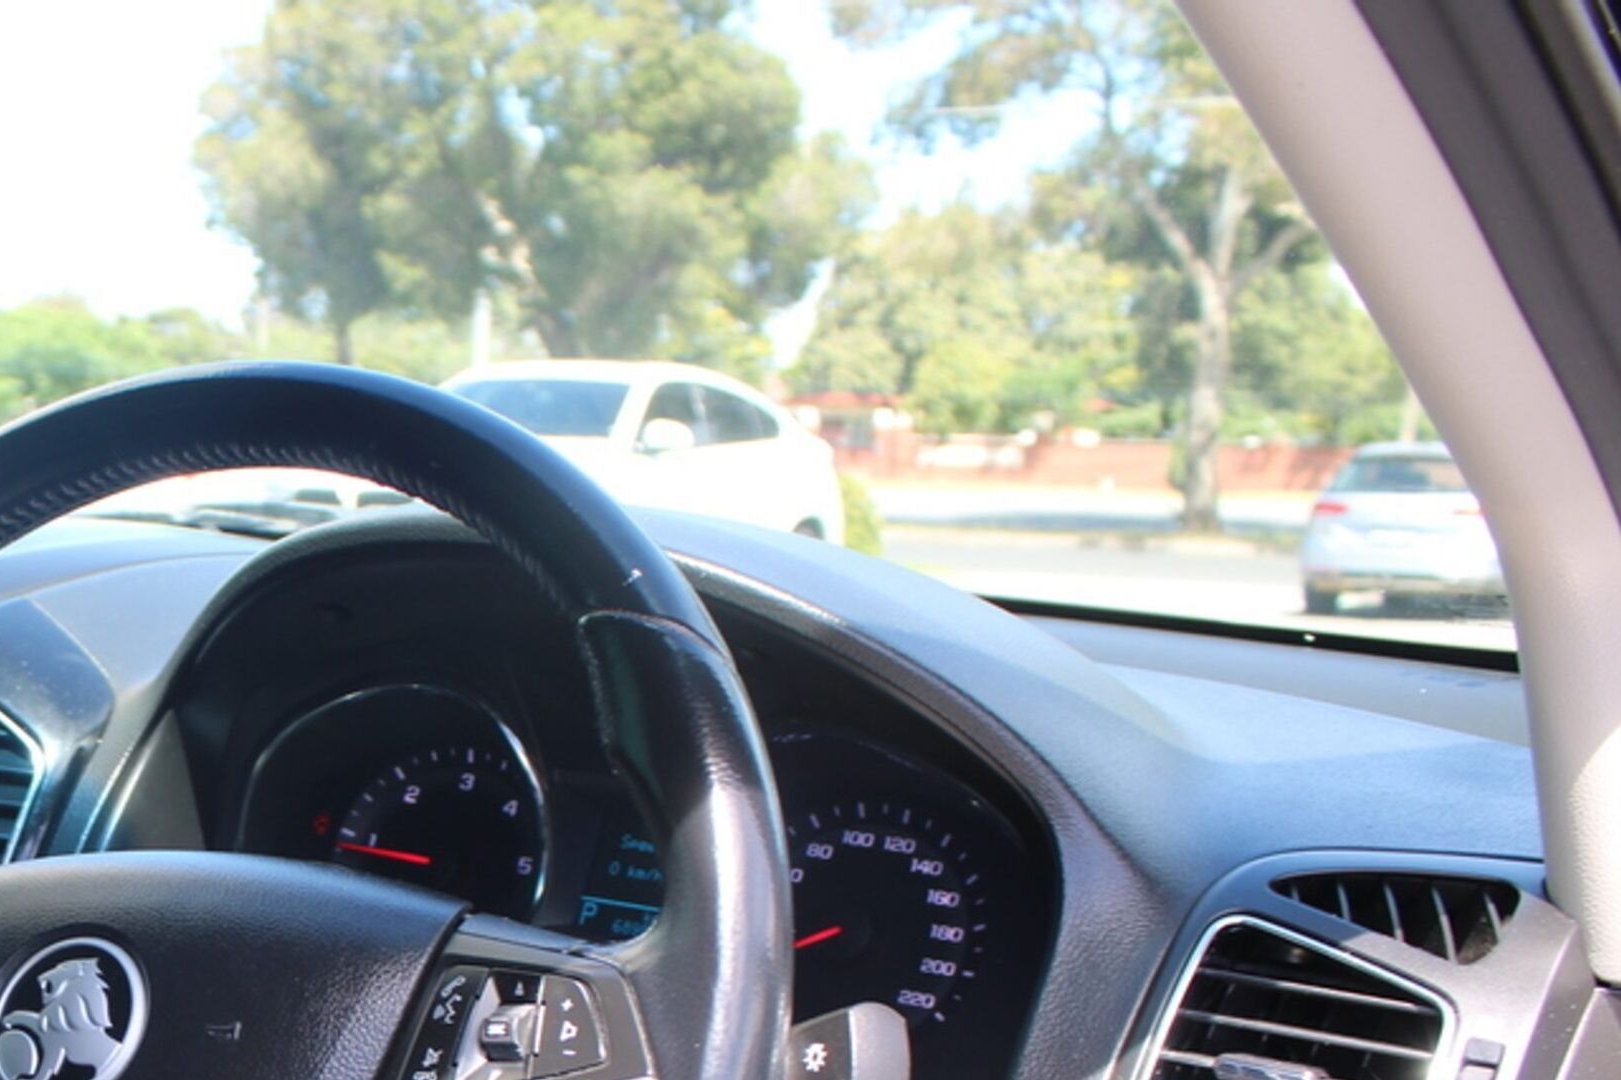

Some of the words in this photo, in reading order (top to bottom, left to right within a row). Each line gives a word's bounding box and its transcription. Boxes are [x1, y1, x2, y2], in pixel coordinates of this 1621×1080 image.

[459, 772, 476, 792] 3
[403, 785, 421, 804] 2
[502, 799, 519, 817] 4
[842, 830, 875, 848] 100
[884, 836, 917, 854] 120
[806, 843, 834, 860] 80
[517, 856, 534, 875] 5
[909, 858, 944, 876] 140
[927, 889, 961, 908] 160
[580, 901, 599, 926] P
[930, 924, 965, 943] 180
[919, 957, 957, 977] 200
[896, 990, 937, 1010] 220
